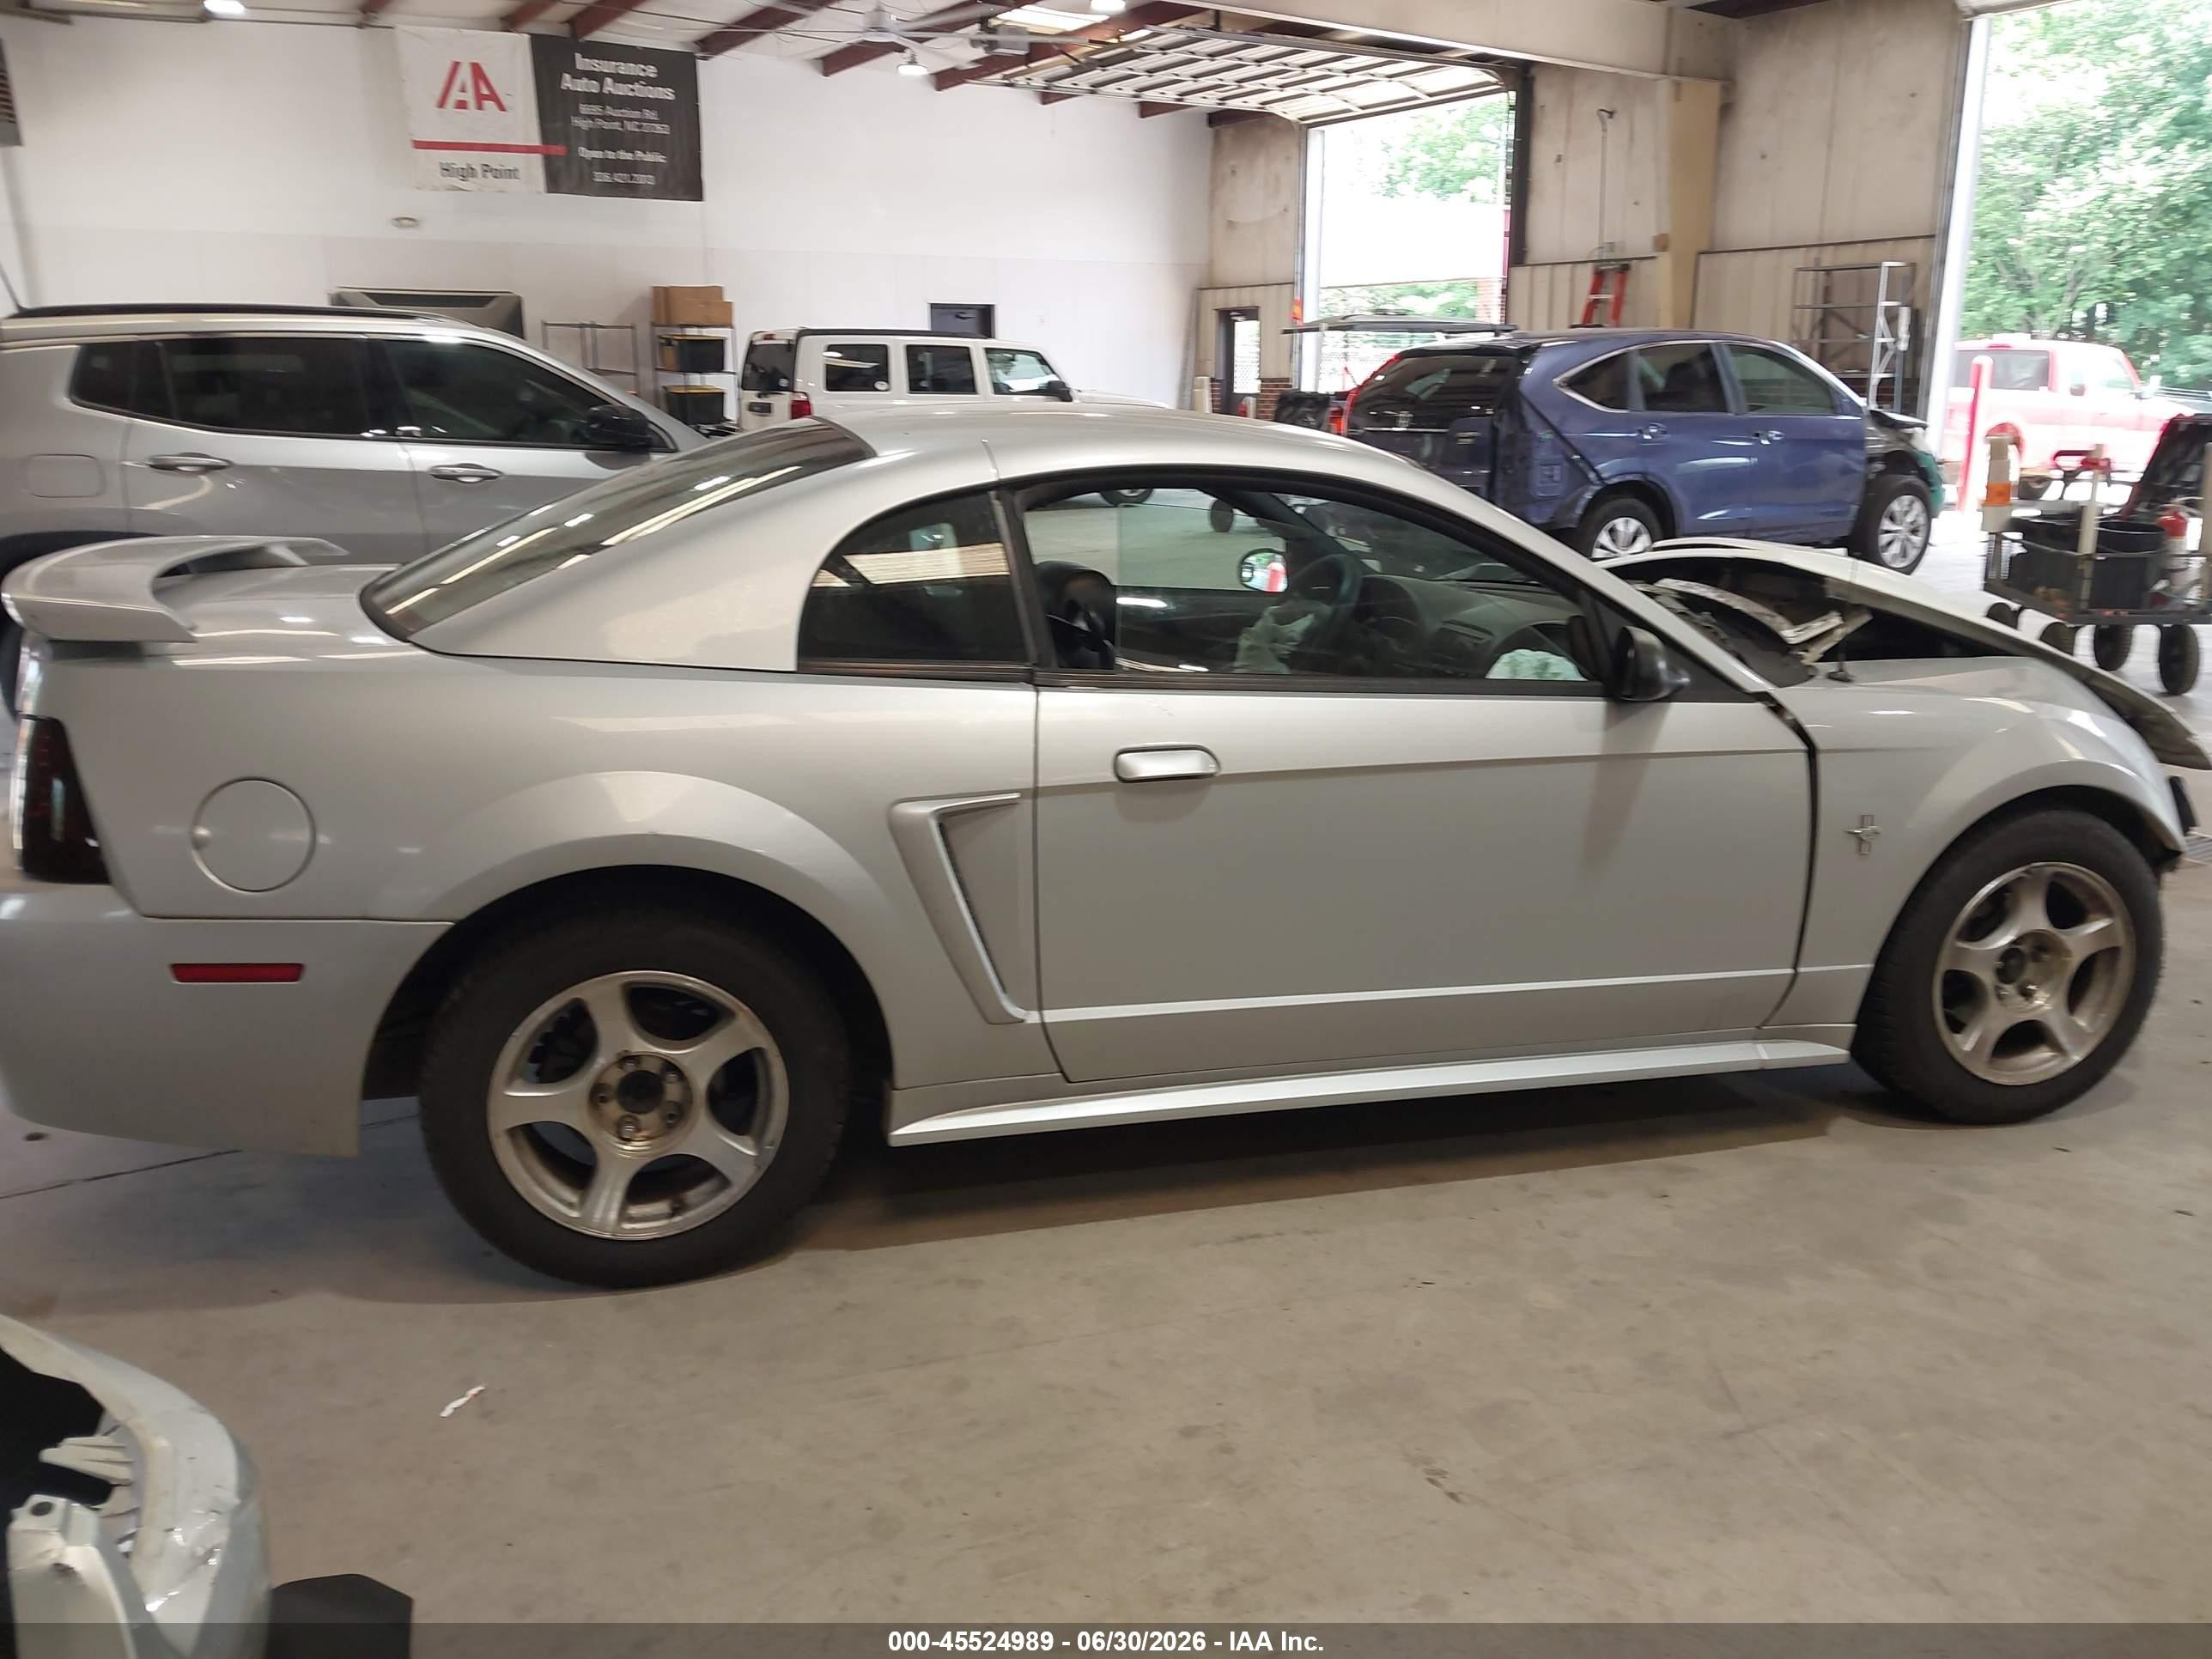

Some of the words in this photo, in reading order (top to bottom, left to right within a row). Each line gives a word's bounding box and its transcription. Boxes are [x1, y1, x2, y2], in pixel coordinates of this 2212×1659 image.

[574, 52, 658, 78] Insurance
[560, 72, 601, 94] Auto
[602, 76, 676, 100] Auctions
[439, 161, 477, 182] High
[480, 163, 521, 179] Point
